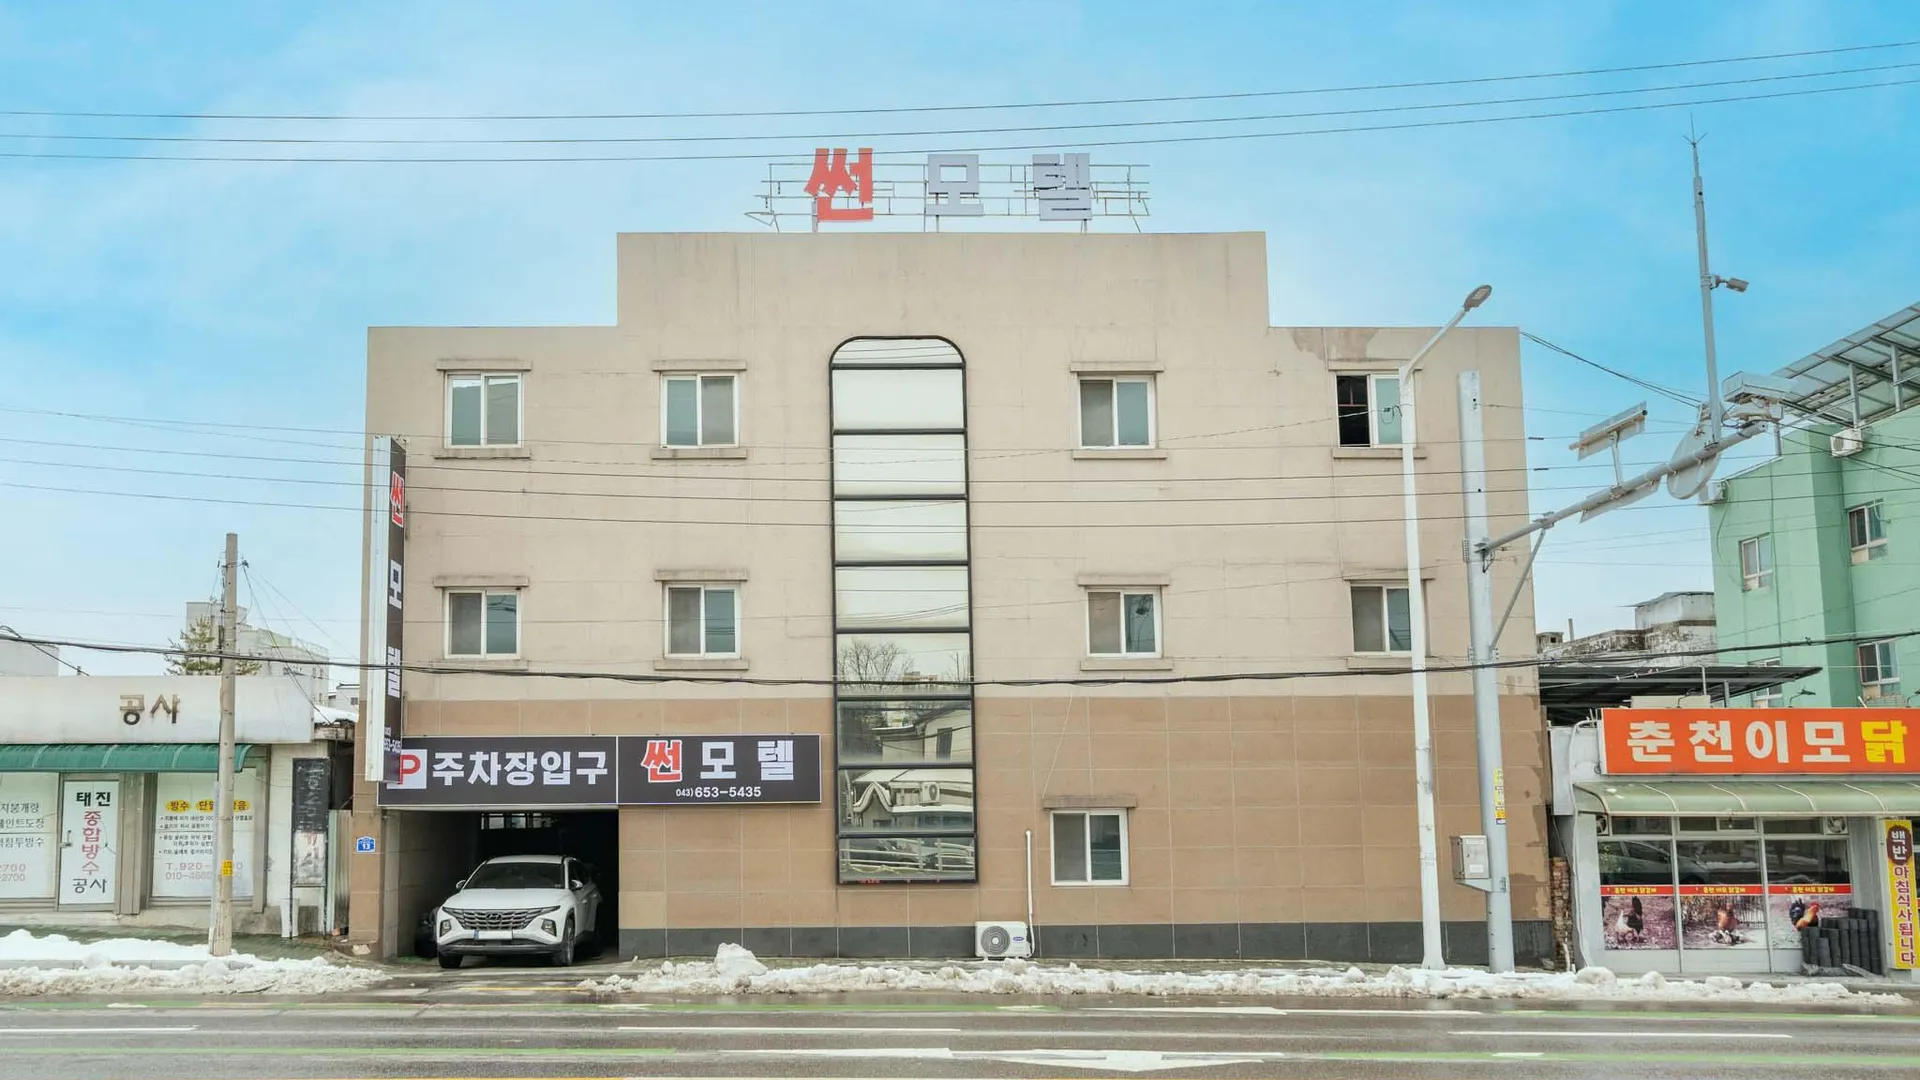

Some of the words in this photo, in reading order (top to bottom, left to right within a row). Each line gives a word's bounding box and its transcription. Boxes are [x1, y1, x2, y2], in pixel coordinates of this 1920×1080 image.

[119, 693, 181, 724] 공사
[399, 754, 421, 785] P
[432, 750, 608, 787] 주차장입구
[76, 791, 111, 807] 태진
[170, 801, 189, 811] 방수
[82, 810, 102, 876] 종합방수
[1891, 830, 1907, 861] 백반
[73, 878, 107, 894] 공사
